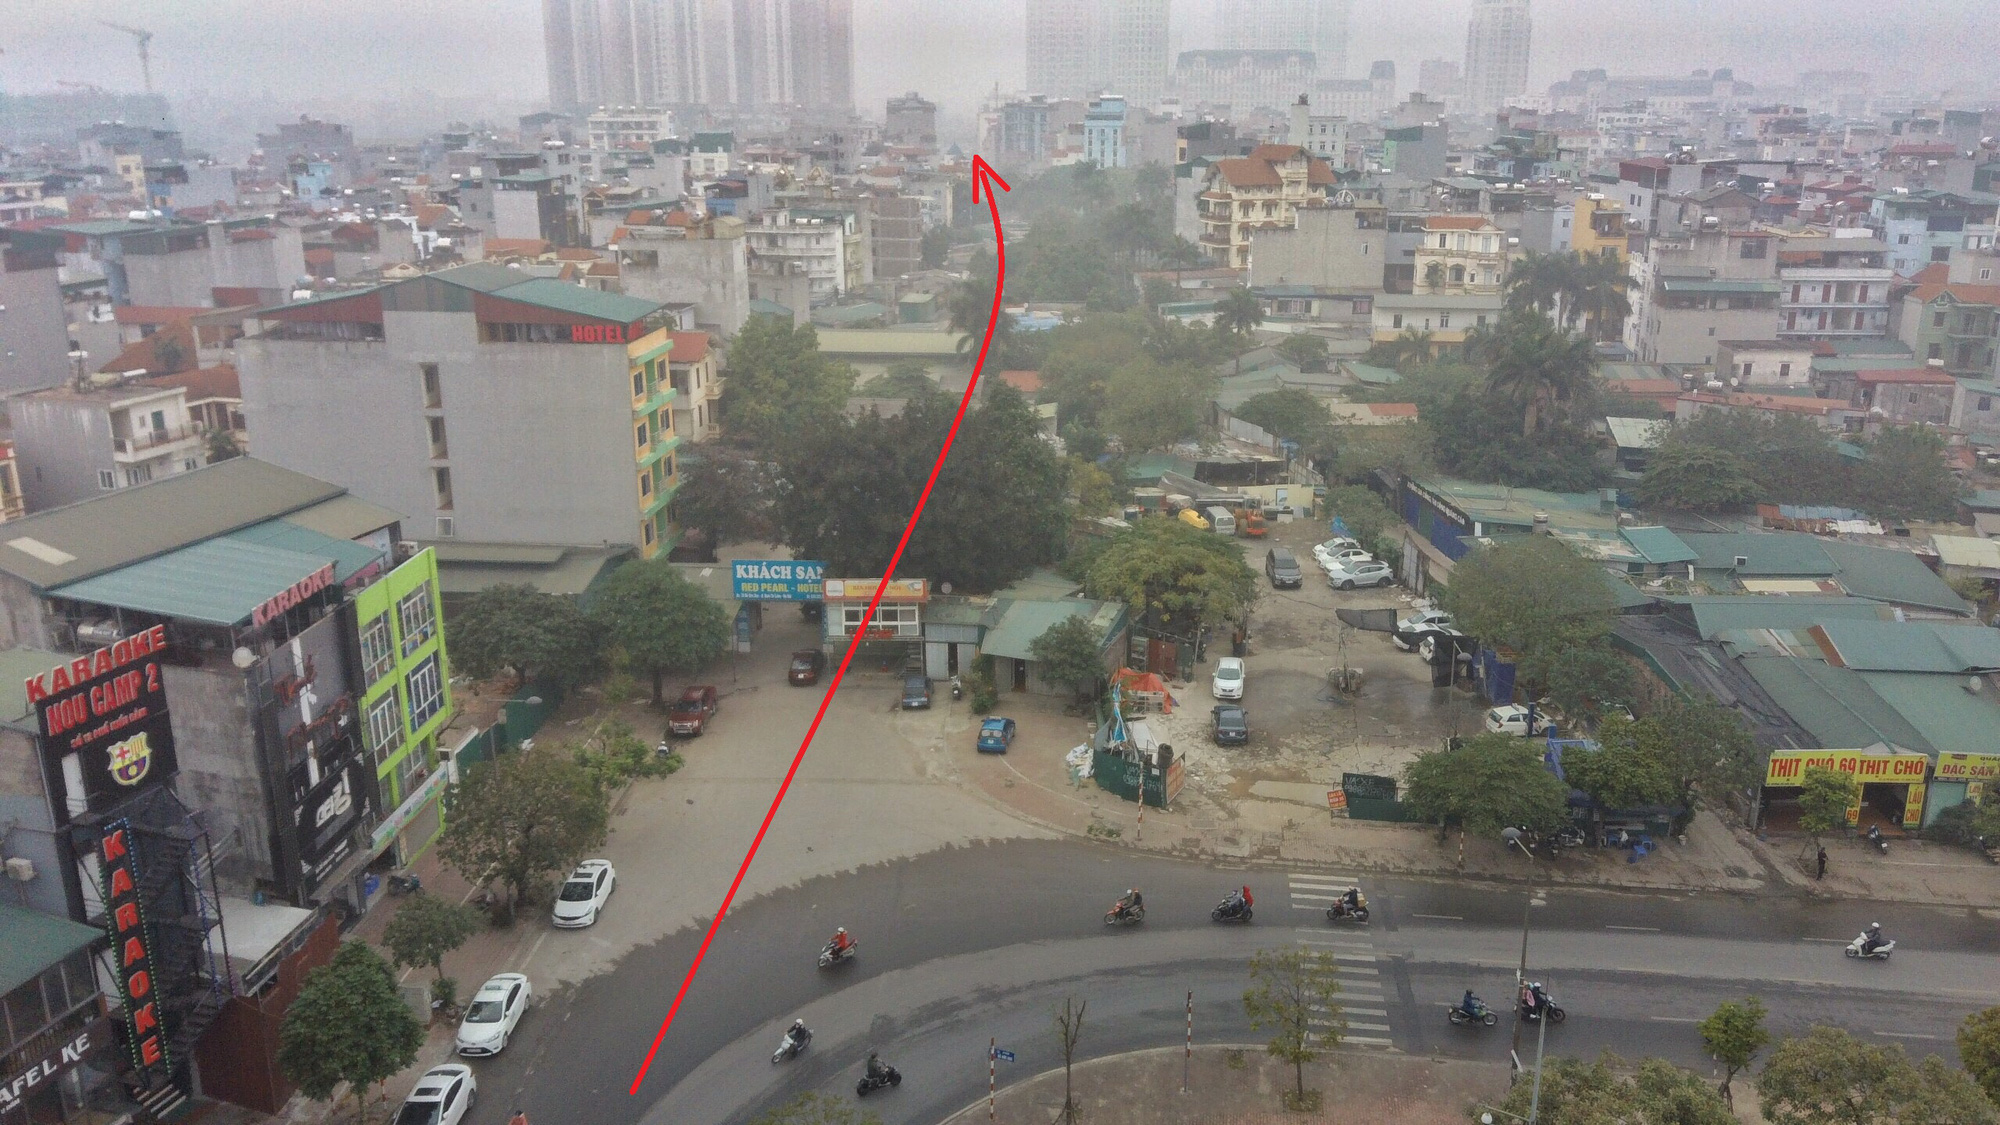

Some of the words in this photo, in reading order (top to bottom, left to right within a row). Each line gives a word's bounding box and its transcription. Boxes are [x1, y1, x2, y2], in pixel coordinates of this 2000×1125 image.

[572, 325, 625, 344] HOTEL
[736, 562, 792, 579] KHÁCH
[252, 562, 335, 628] KARAOKE
[761, 583, 788, 593] PEARL
[797, 583, 823, 593] HOTEL
[25, 624, 167, 704] KARAOKE
[46, 693, 88, 746] NOU
[90, 670, 142, 716] CAMP
[145, 663, 159, 692] 2
[1770, 758, 1802, 782] THỊT
[1839, 757, 1857, 775] 69
[1859, 760, 1890, 778] THỊT
[1893, 758, 1924, 775] CHÓ
[1846, 809, 1859, 820] 69
[102, 829, 161, 1066] KARAOKE
